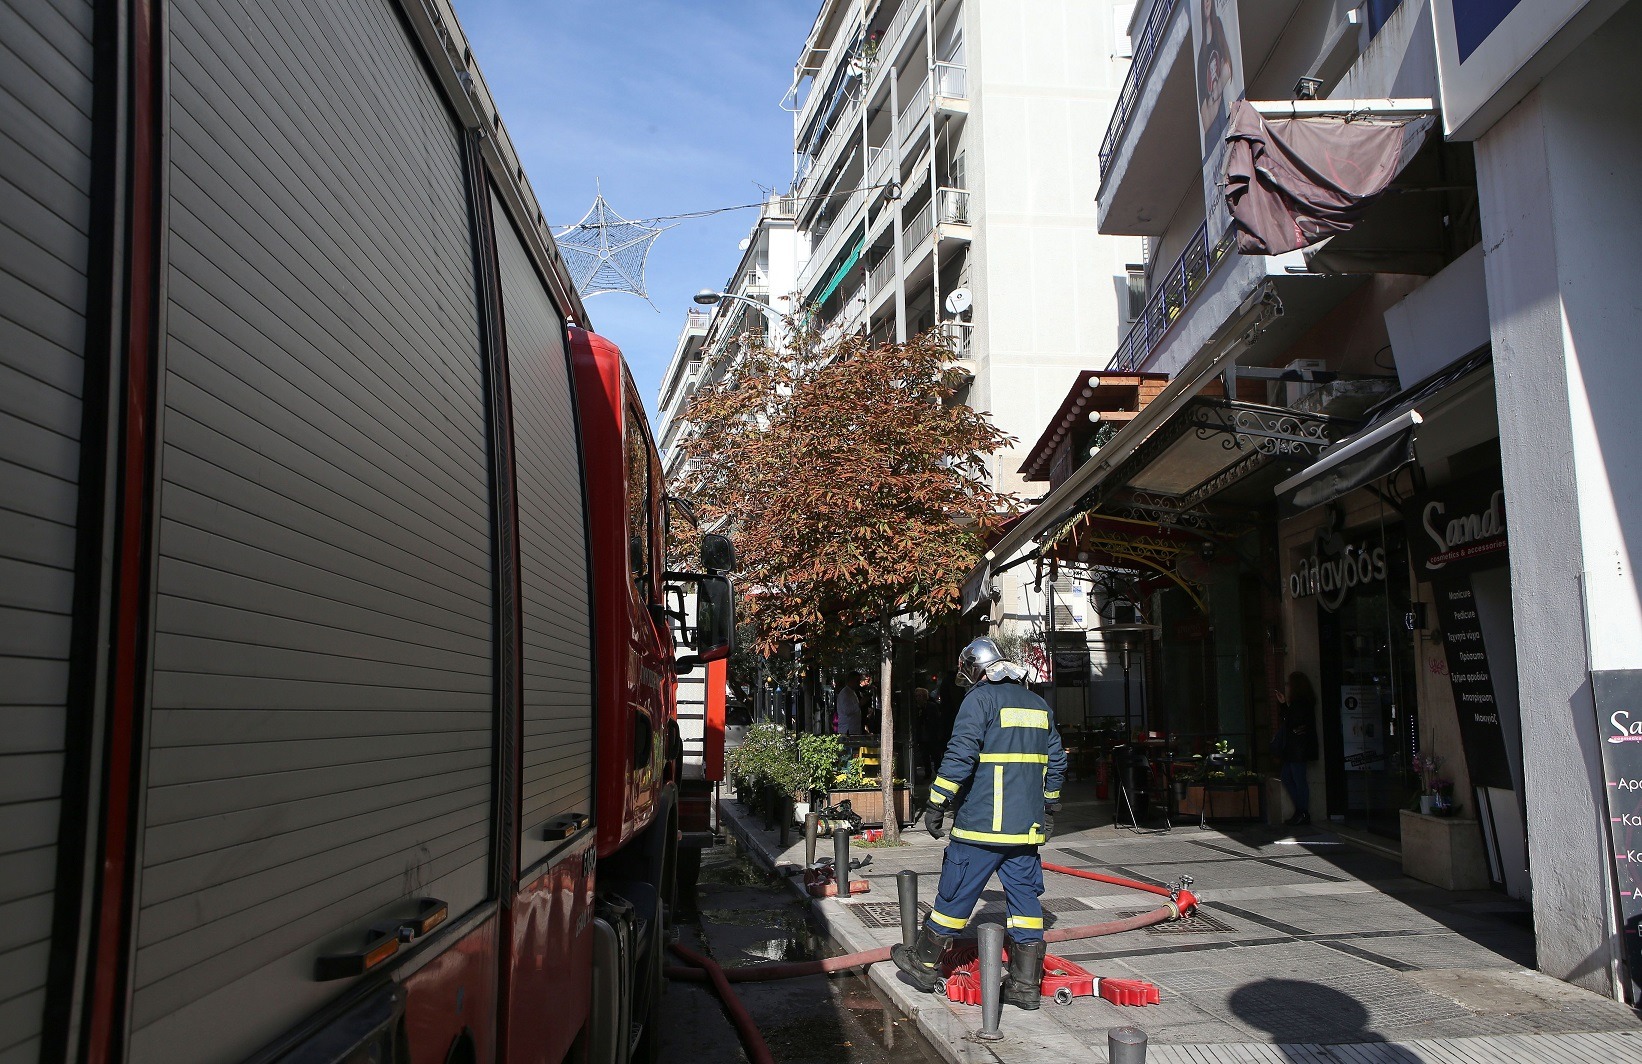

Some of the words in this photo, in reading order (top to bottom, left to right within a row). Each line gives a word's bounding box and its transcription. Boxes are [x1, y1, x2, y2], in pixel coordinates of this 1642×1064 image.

[1430, 551, 1460, 564] cosmetics
[1460, 549, 1466, 557] &
[1467, 540, 1507, 555] accessories
[1448, 589, 1472, 600] Manicure
[1453, 610, 1476, 621] Pedicure
[1459, 651, 1484, 662] Πρόσωπο
[1462, 692, 1494, 704] Αποτρίχωση
